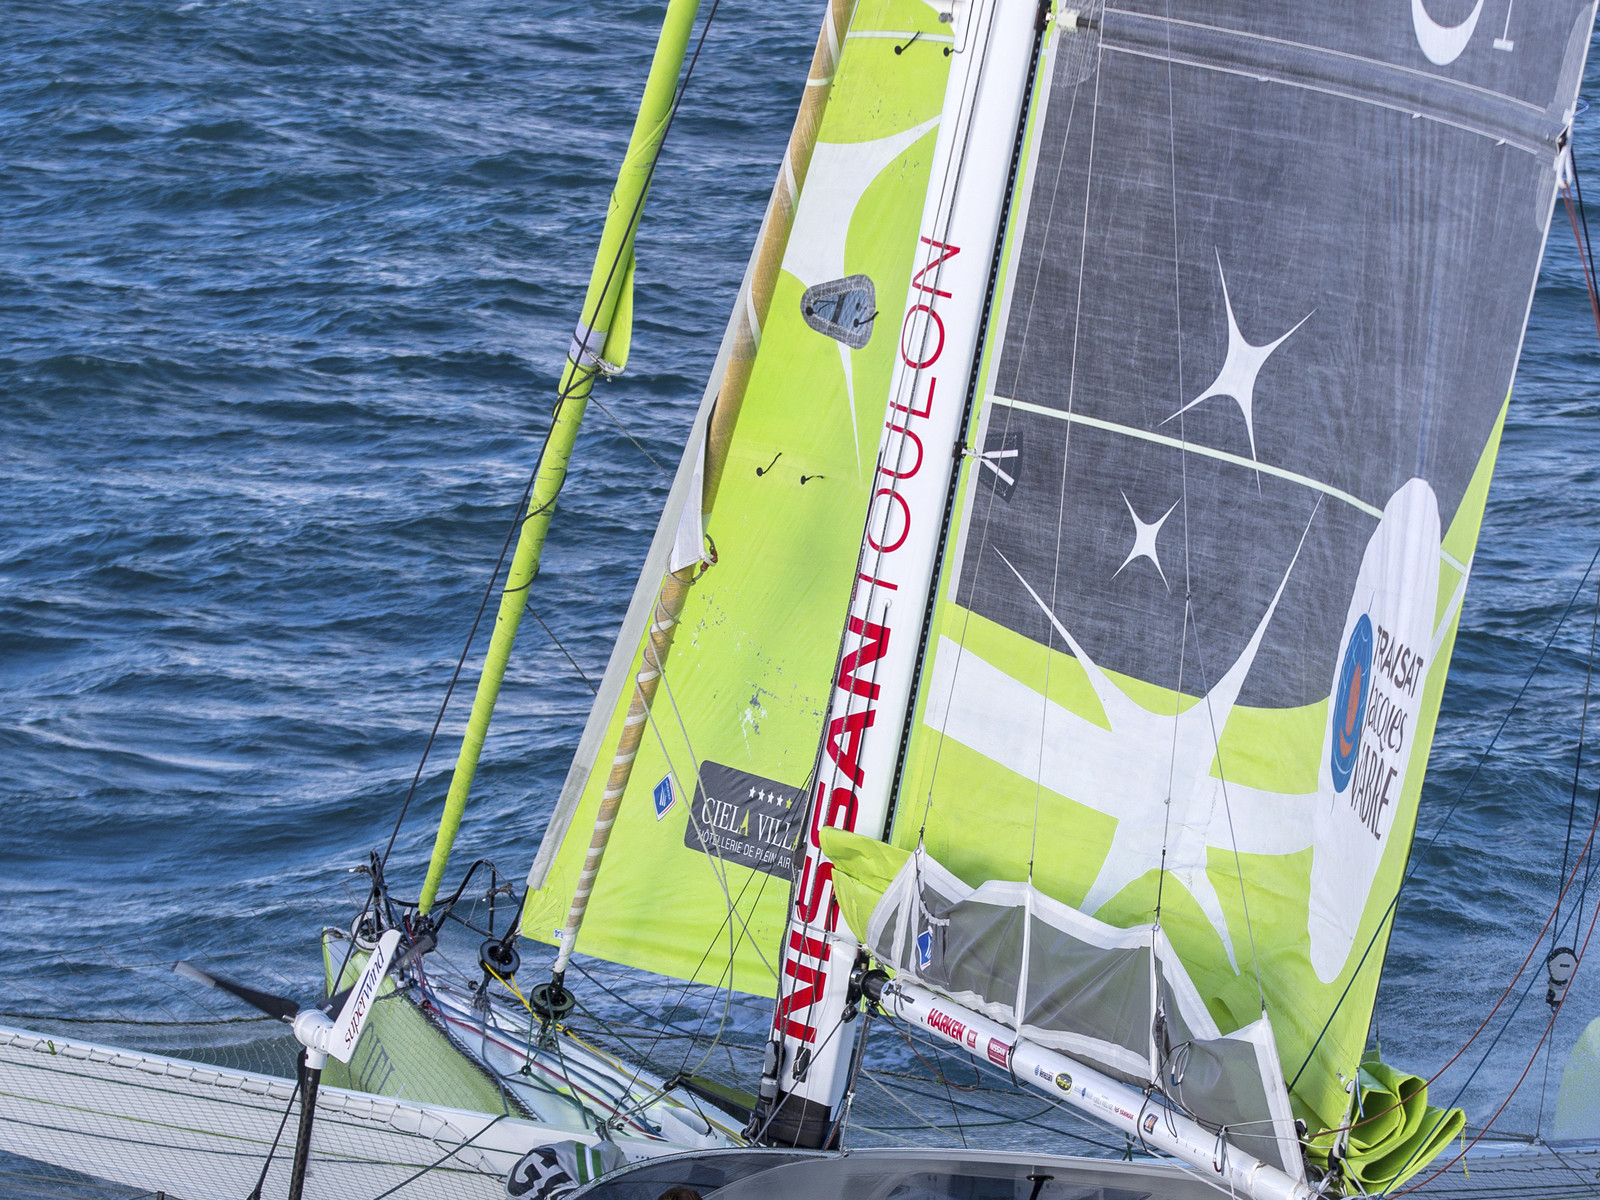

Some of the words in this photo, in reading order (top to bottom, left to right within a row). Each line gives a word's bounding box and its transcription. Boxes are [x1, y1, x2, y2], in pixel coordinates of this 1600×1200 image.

[774, 614, 891, 1044] NISSAN
[853, 235, 961, 601] TOULON
[701, 797, 749, 837] CIELA
[743, 843, 753, 857] DE
[755, 847, 777, 863] PLEIN
[777, 856, 791, 869] AIR
[344, 944, 385, 1050] superwind
[927, 1008, 967, 1042] HARKEN
